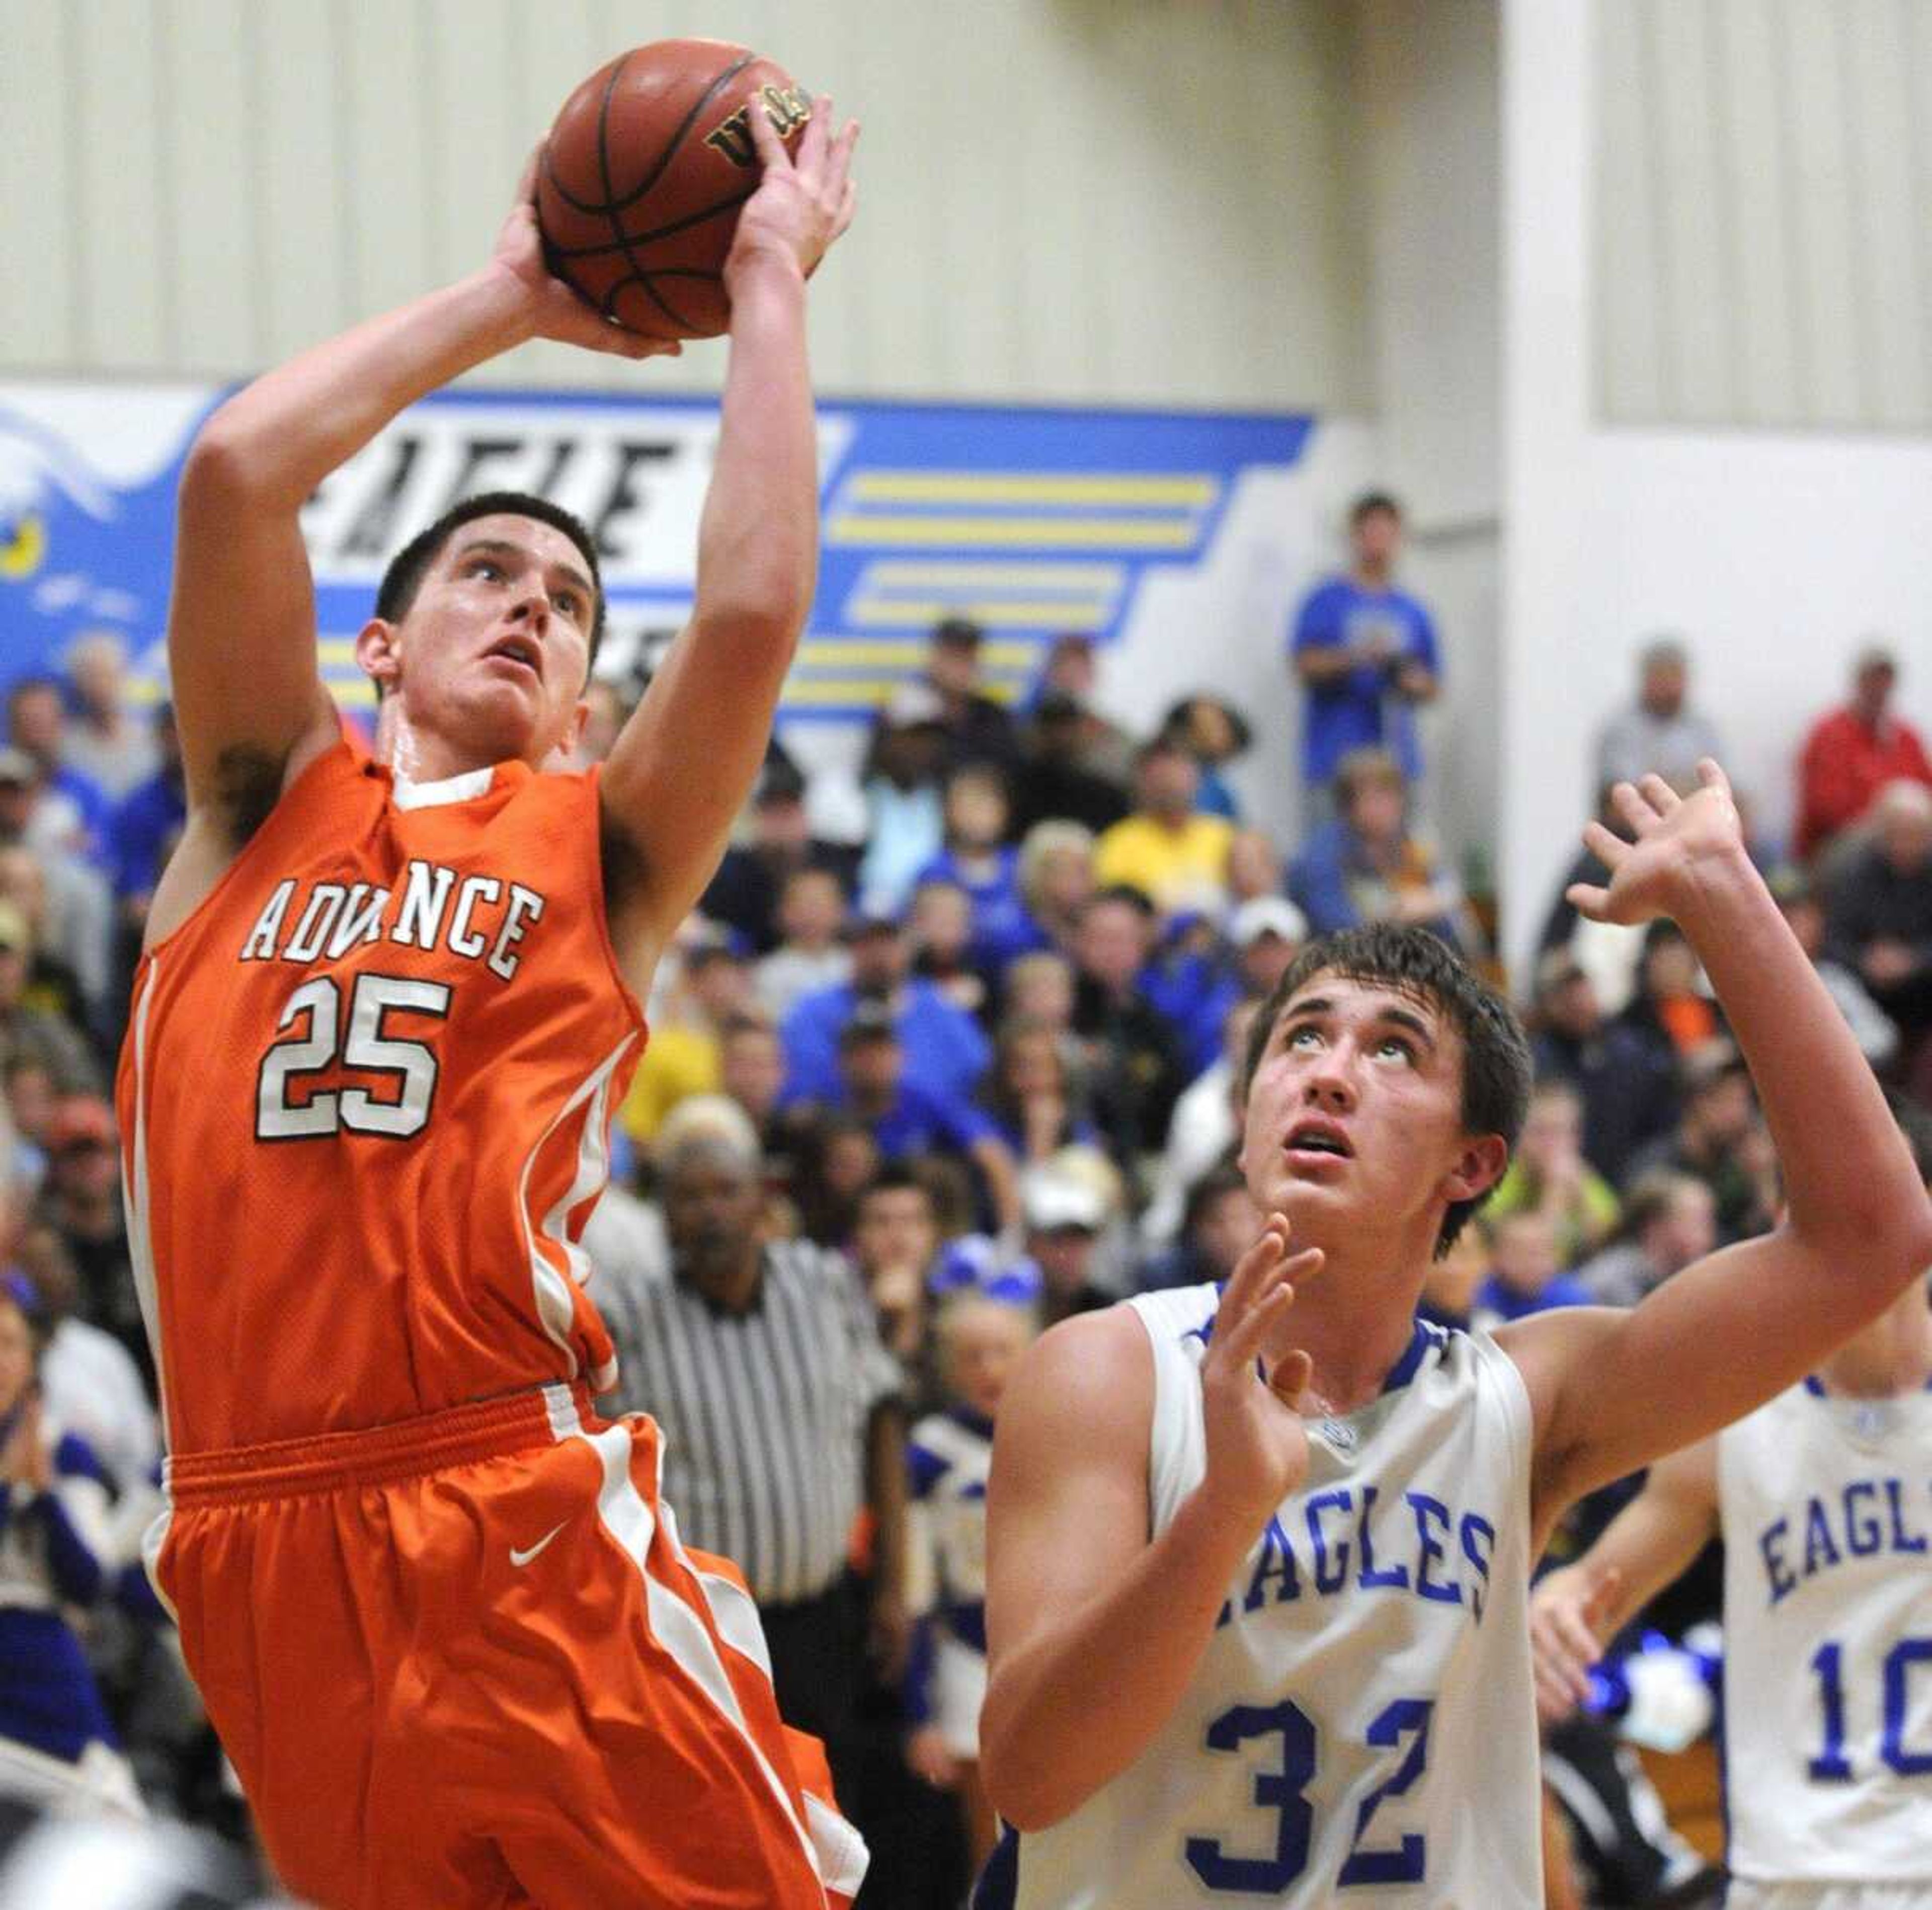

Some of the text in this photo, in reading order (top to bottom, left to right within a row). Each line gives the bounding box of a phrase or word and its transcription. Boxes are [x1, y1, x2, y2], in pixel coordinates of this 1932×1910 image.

[255, 973, 453, 1142] 25
[1215, 1487, 1495, 1629] AGLES
[1760, 1478, 1932, 1605] EAGL
[1185, 1697, 1436, 1894] 32
